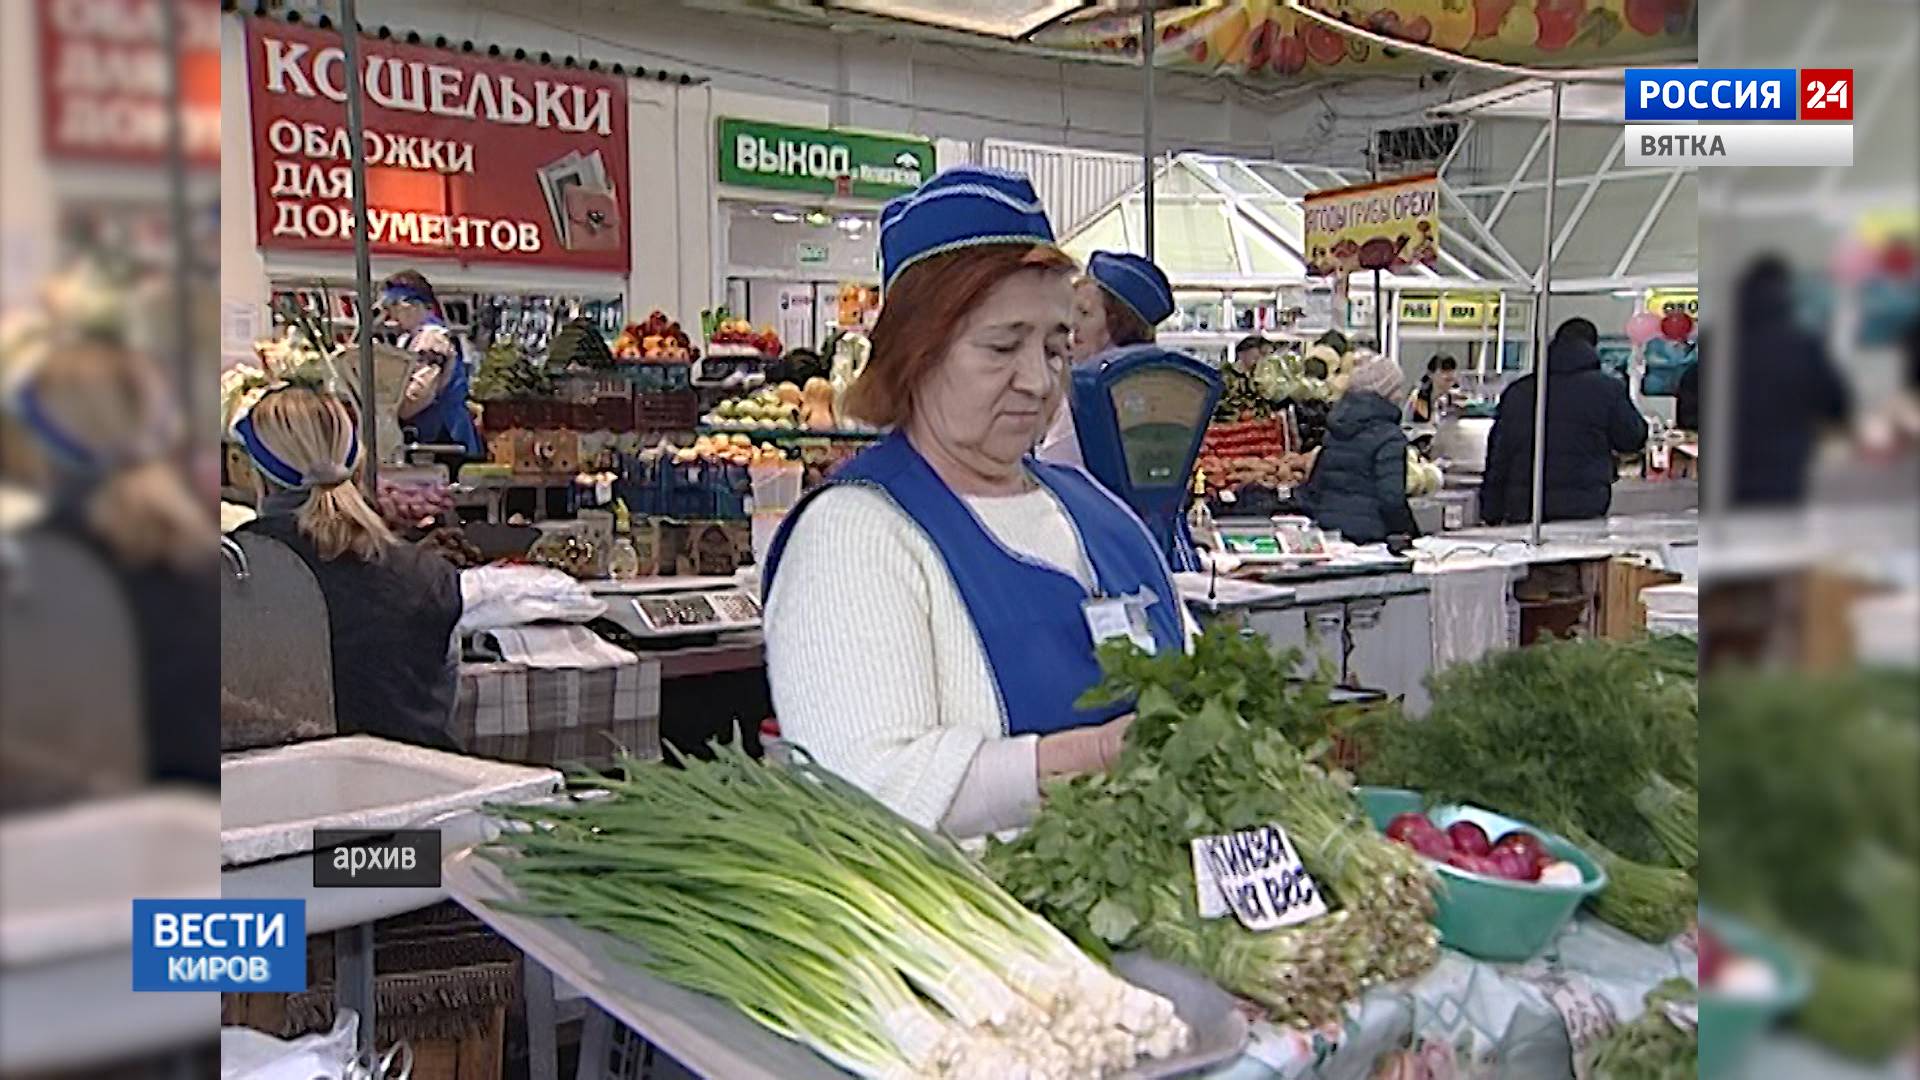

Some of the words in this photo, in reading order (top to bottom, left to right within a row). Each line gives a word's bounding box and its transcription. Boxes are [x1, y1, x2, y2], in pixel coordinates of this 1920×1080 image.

[263, 38, 612, 136] КОШЕЛЬКИ
[269, 118, 476, 174] ОБЛОЖКИ
[737, 133, 850, 180] ВЫХОД
[270, 160, 354, 199] ДЛЯ
[272, 200, 541, 252] ДОКУМЕНТОВ
[1393, 189, 1437, 221] ОРЕХИ
